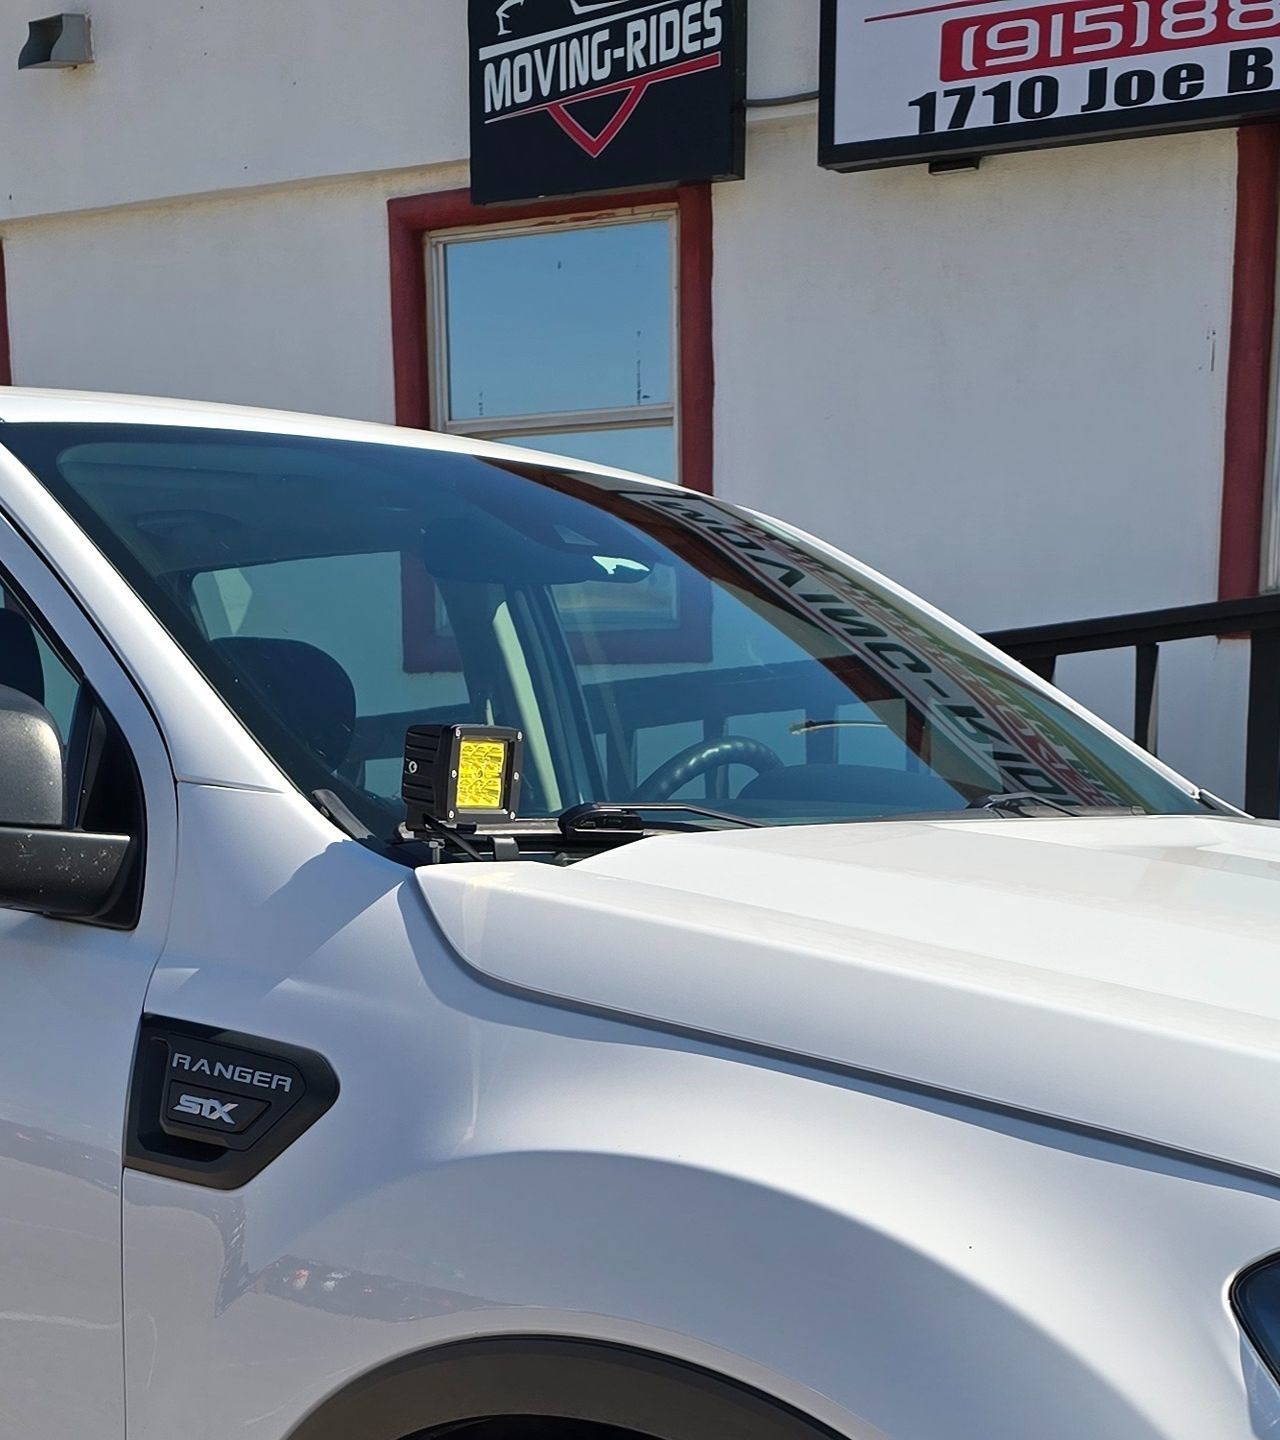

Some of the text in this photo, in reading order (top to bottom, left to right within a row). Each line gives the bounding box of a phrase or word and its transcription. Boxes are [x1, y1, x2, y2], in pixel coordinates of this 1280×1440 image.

[483, 1, 722, 114] MOVING-RIDES
[908, 74, 1060, 136] 1710
[1081, 62, 1206, 113] Joe
[171, 1052, 293, 1093] RANGER
[172, 1093, 239, 1125] STX
